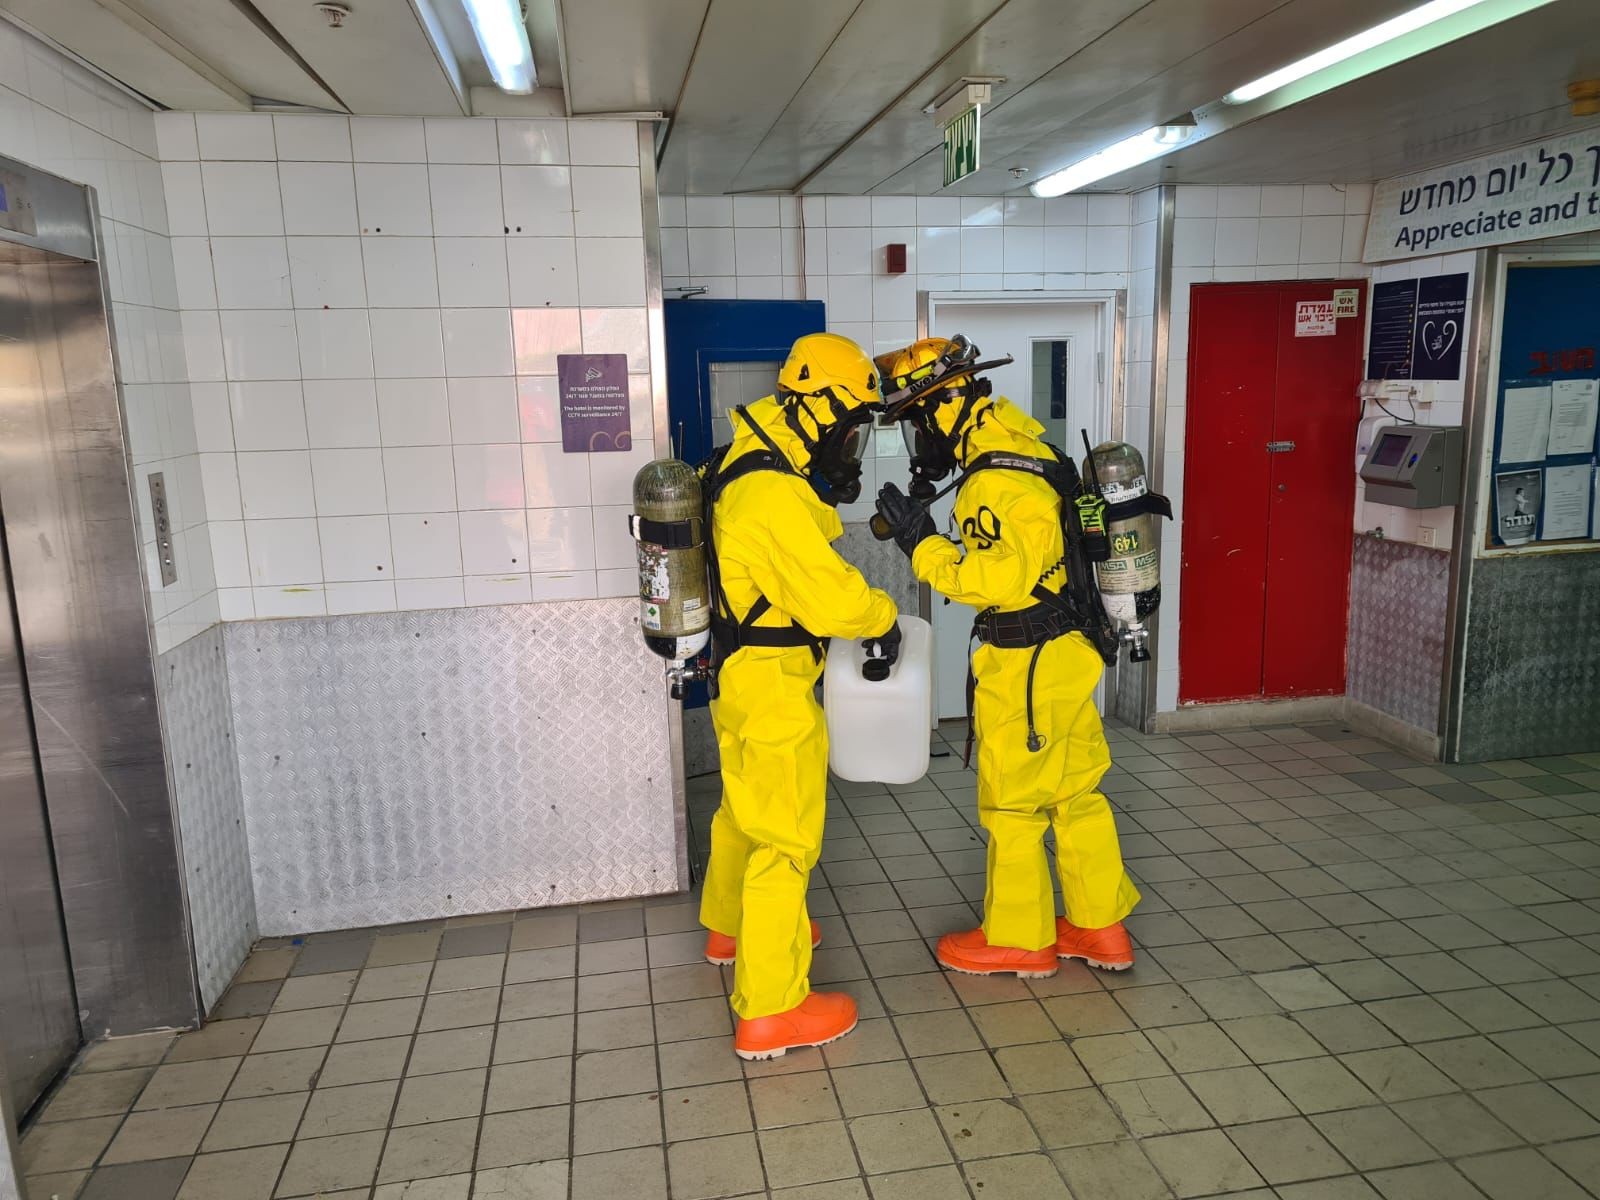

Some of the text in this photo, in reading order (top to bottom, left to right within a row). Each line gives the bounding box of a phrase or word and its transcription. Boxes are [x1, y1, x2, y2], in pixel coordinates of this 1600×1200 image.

[1486, 162, 1527, 197] יום
[1538, 148, 1574, 187] כל
[1400, 175, 1476, 215] מחדש
[1394, 209, 1522, 252] Appreciate
[1529, 192, 1580, 225] and
[1588, 192, 1600, 215] t
[1298, 315, 1312, 323] אש
[1337, 305, 1356, 313] FIRE
[1338, 297, 1354, 305] אש
[963, 505, 1001, 550] 30
